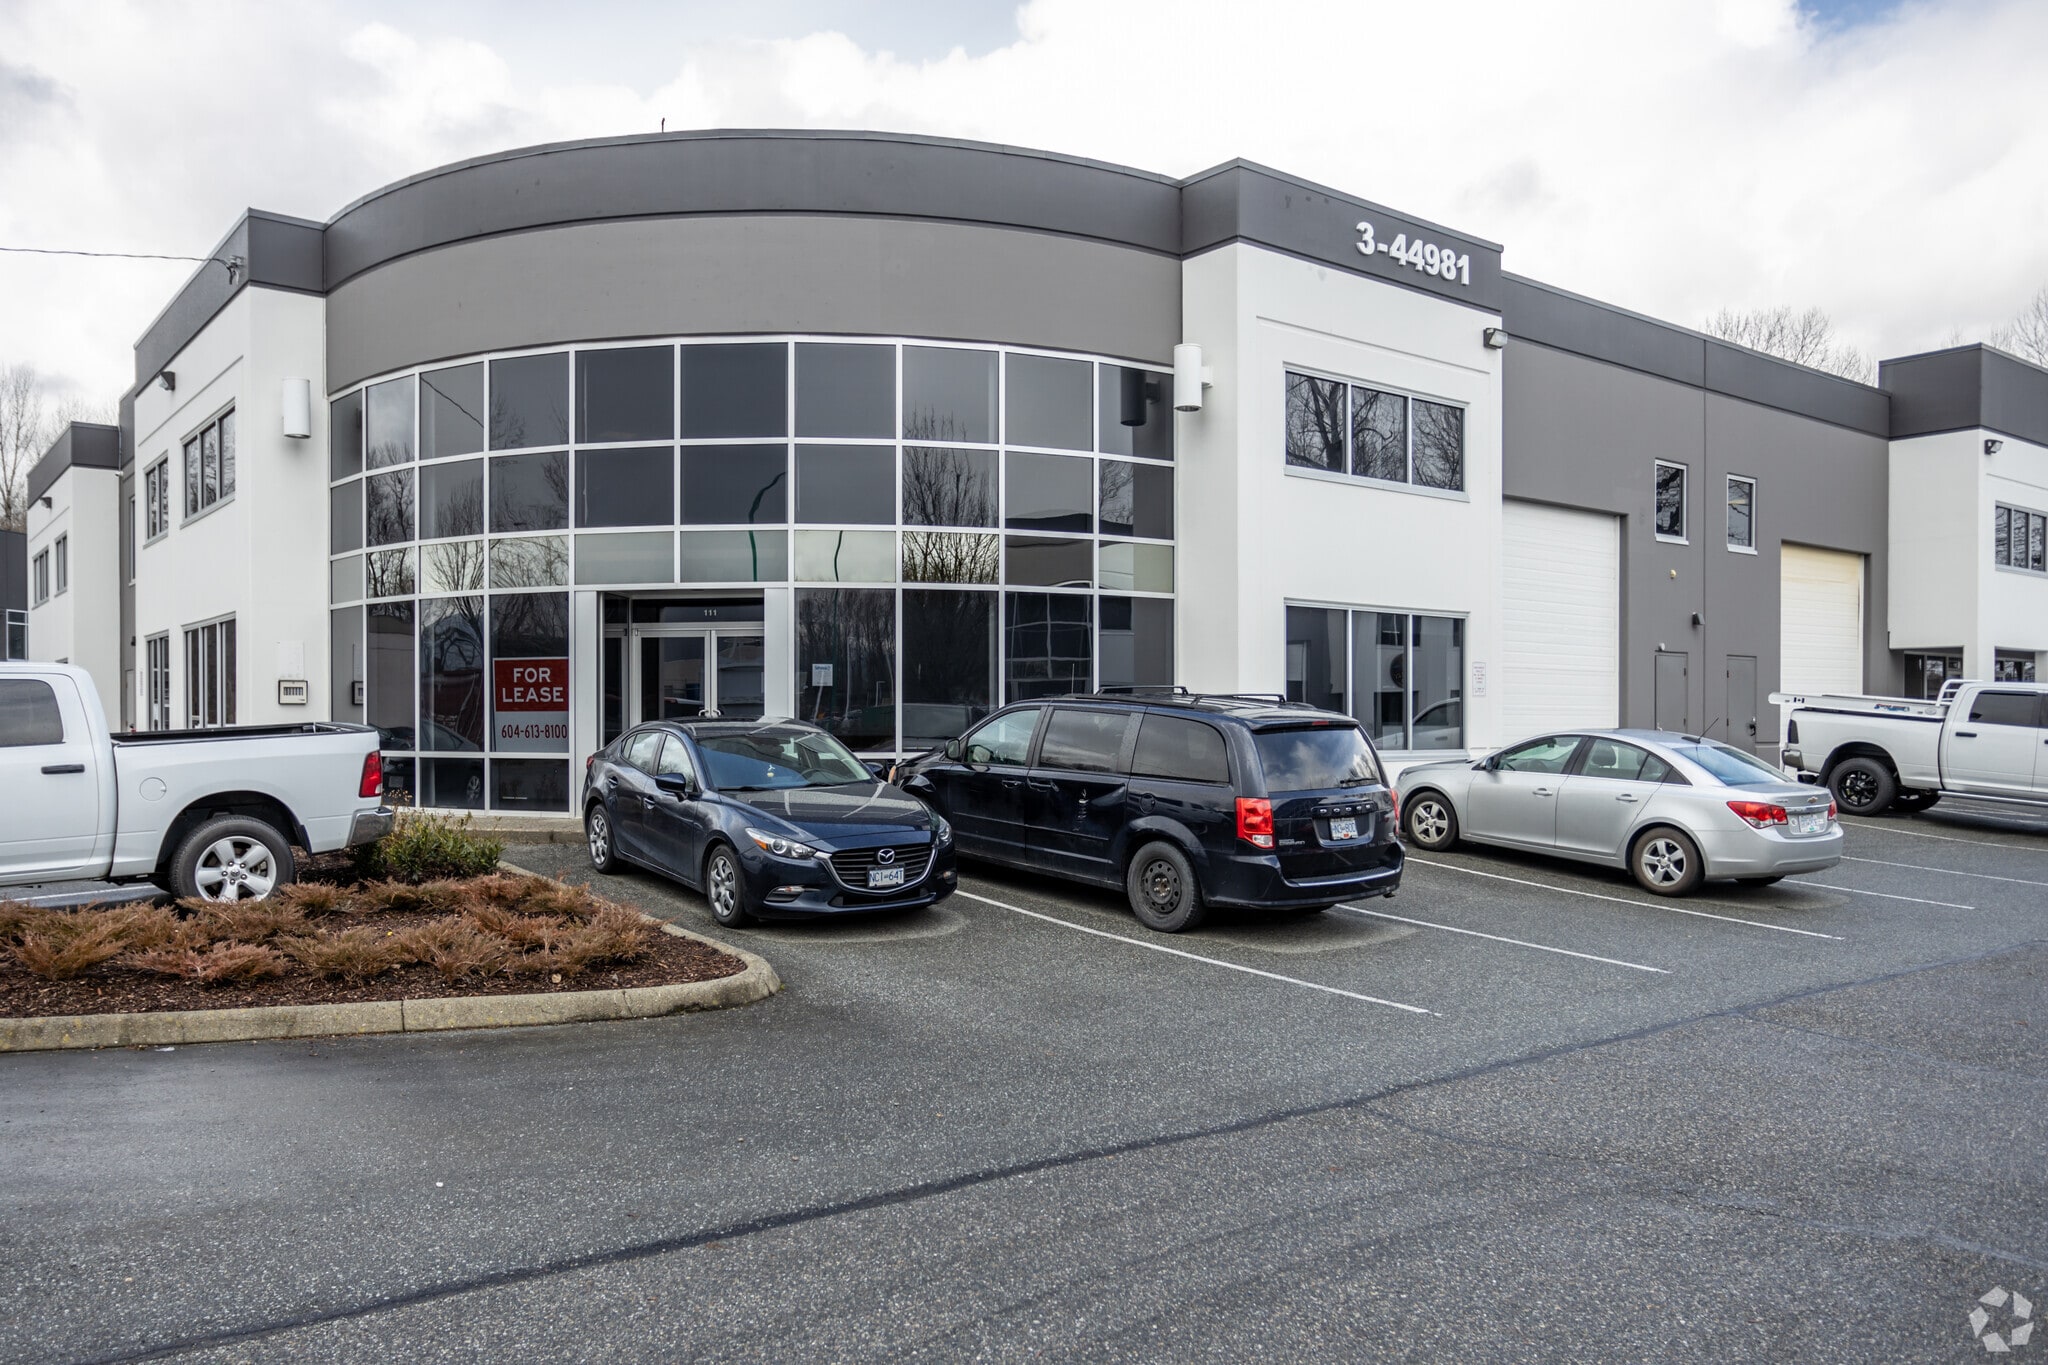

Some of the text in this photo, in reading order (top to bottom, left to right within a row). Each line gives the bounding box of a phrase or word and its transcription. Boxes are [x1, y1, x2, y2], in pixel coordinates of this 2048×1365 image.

[1356, 221, 1470, 286] 3-44981
[703, 609, 717, 617] 111
[513, 667, 552, 683] FOR
[502, 687, 564, 703] LEASE
[501, 724, 568, 739] 604-613-8100
